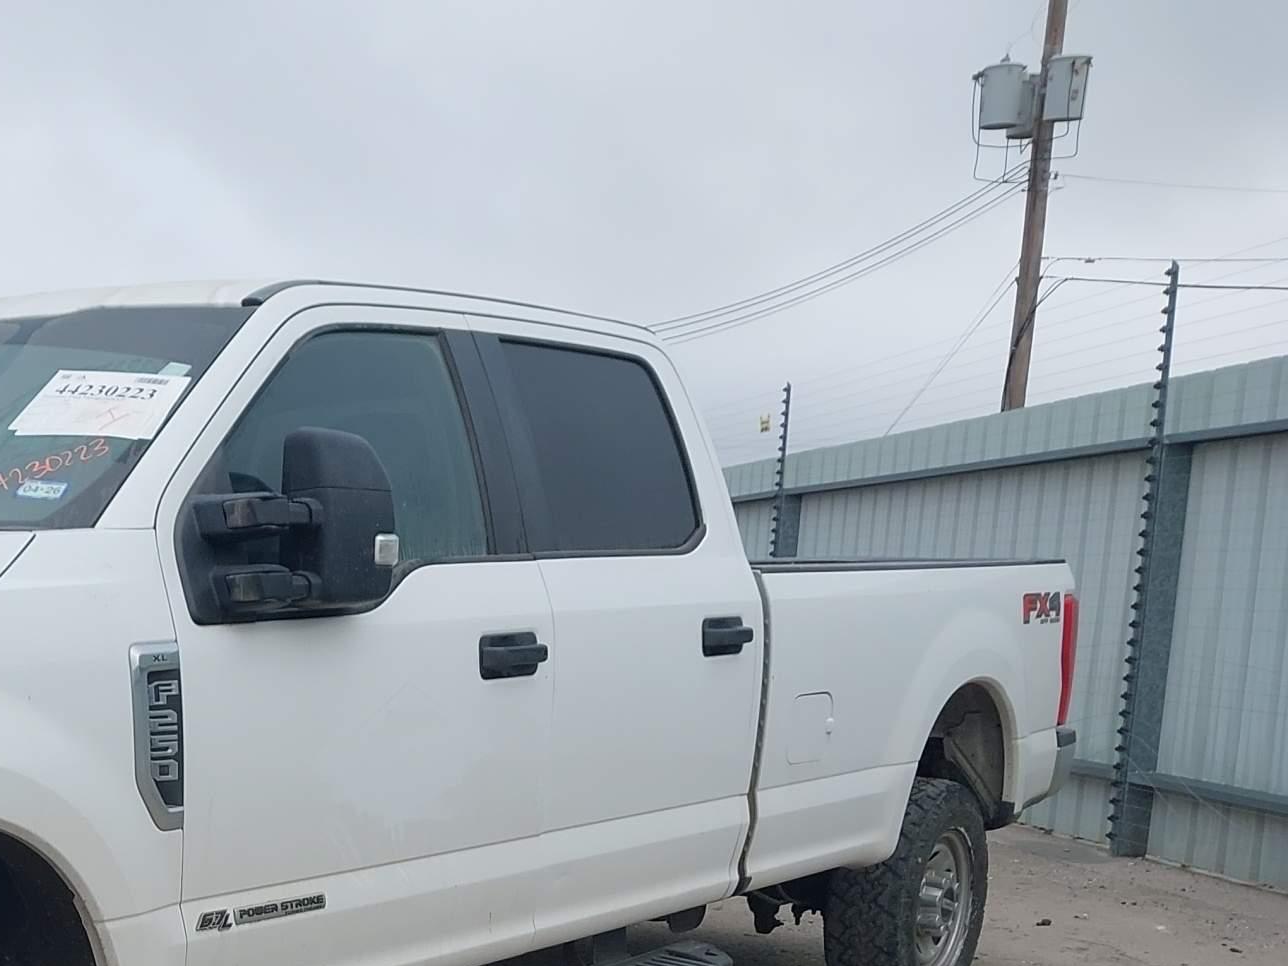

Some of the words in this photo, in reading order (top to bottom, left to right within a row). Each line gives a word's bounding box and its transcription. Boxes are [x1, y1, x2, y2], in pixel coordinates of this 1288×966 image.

[54, 383, 158, 401] 44230223
[1022, 592, 1061, 624] FX4
[152, 654, 169, 662] XL
[238, 903, 279, 919] POWER
[280, 894, 325, 911] STROKE
